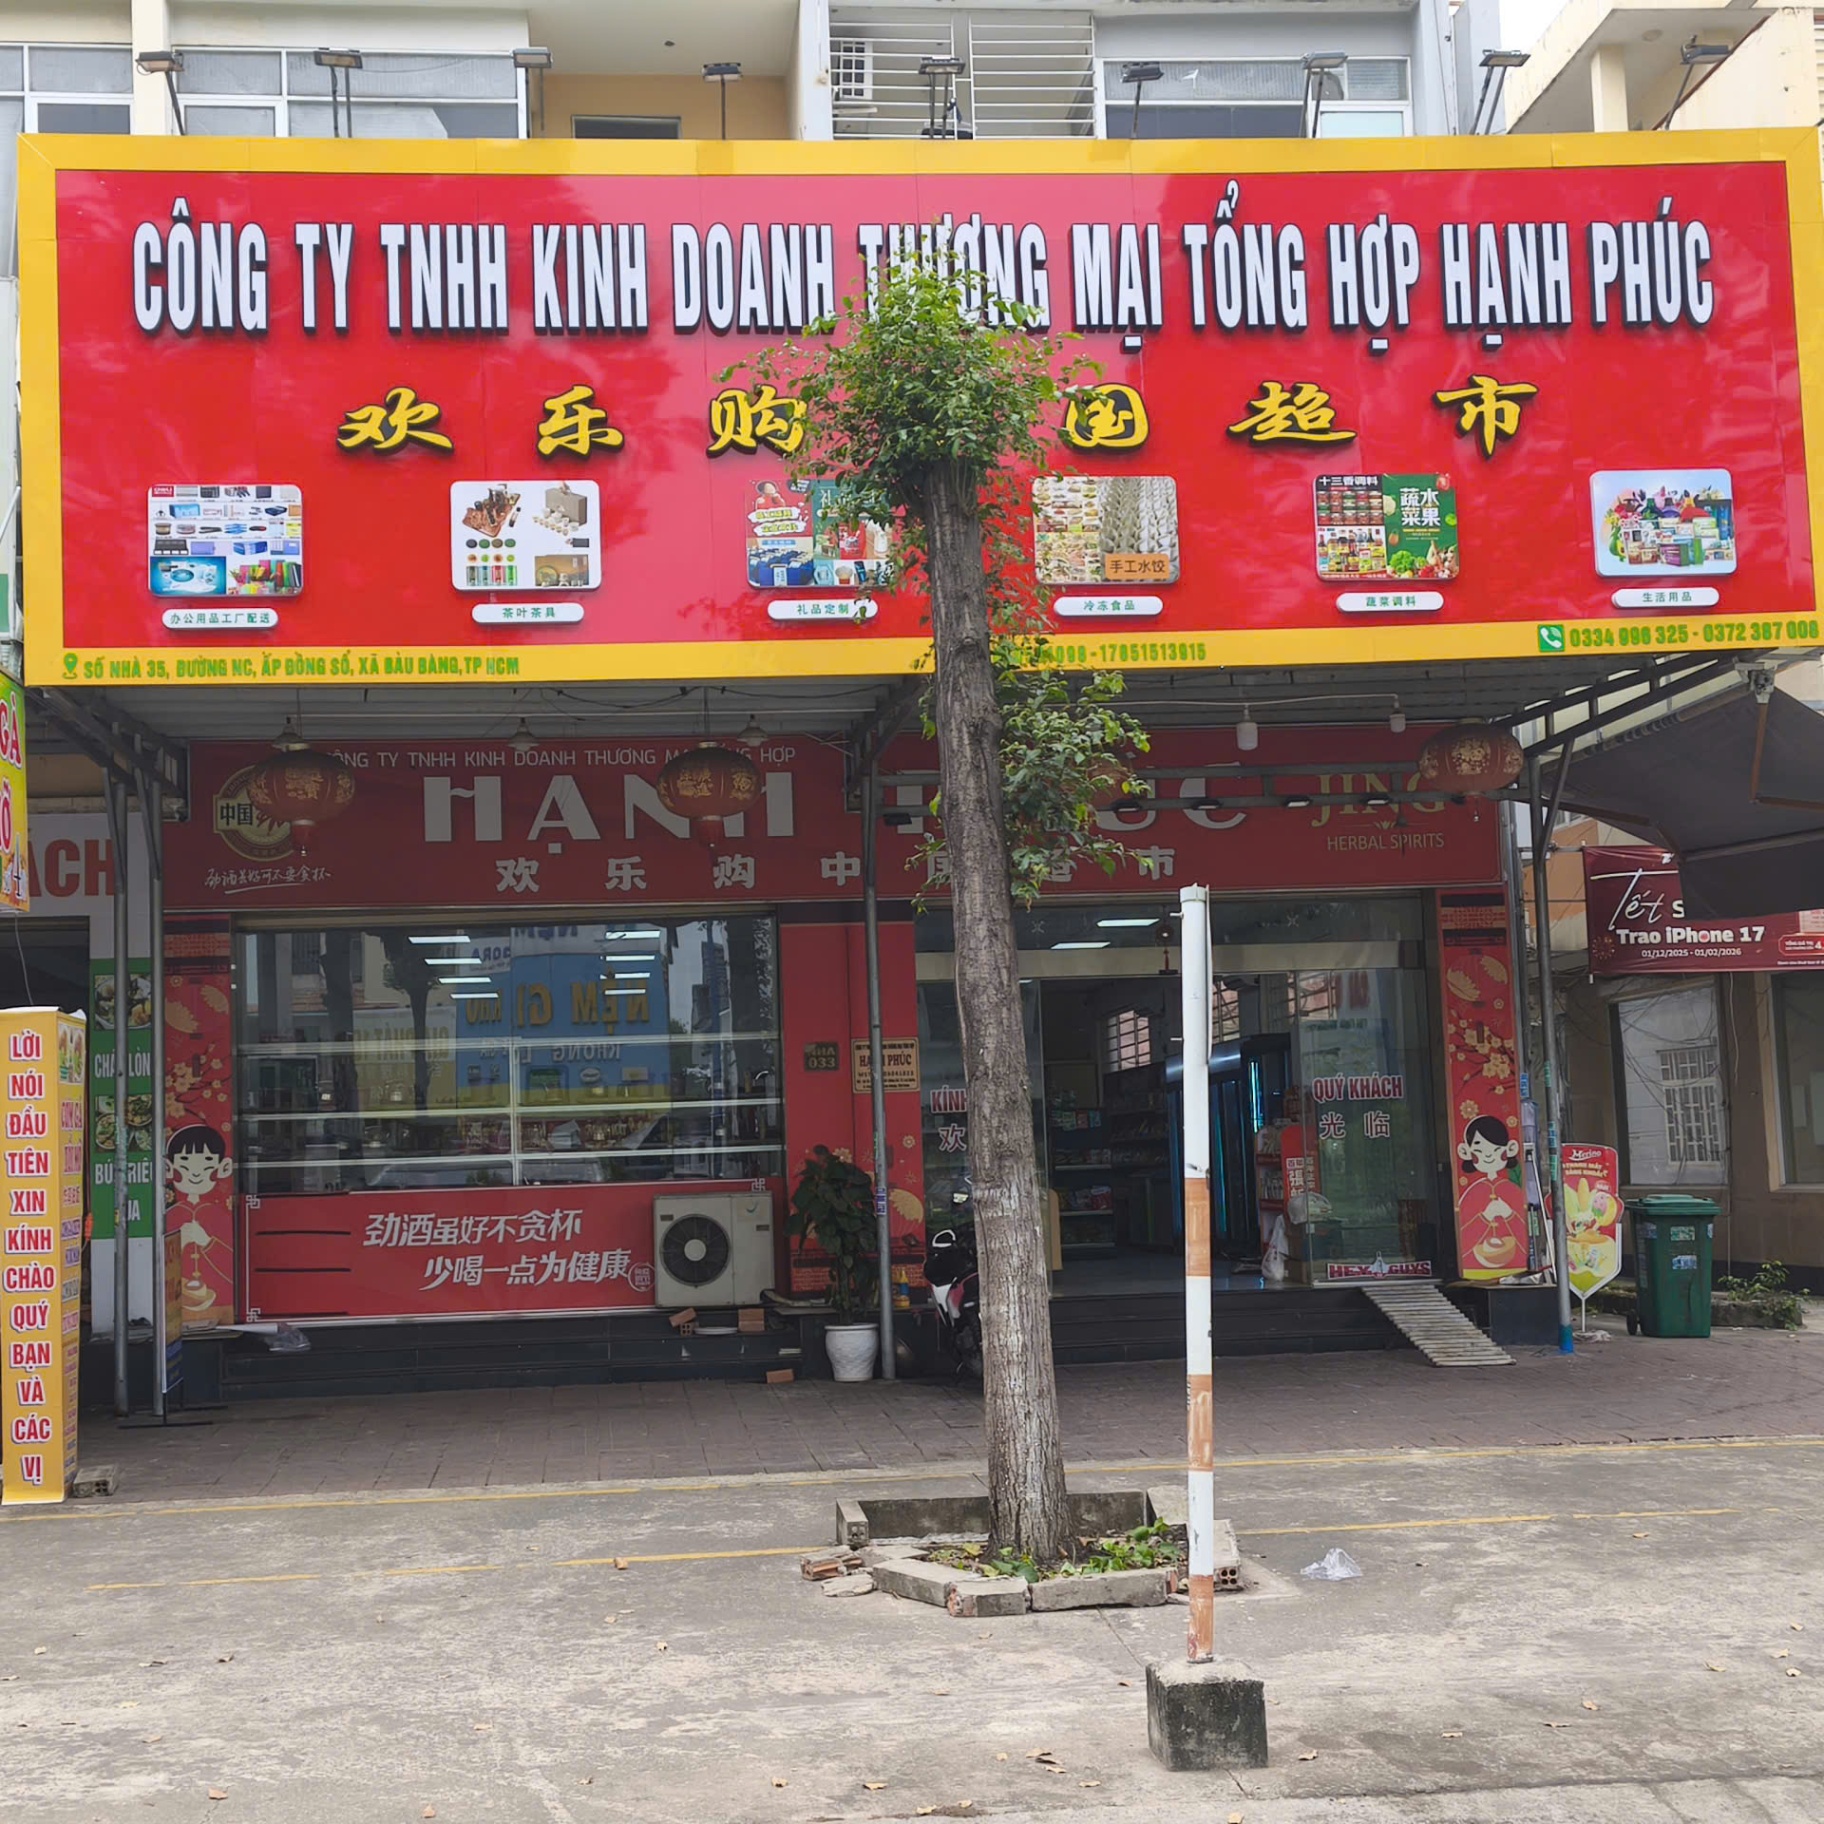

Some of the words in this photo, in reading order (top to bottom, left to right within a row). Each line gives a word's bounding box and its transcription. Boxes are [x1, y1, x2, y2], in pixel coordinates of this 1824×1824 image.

[132, 196, 268, 331] CÔNG
[294, 222, 353, 330] TY
[380, 222, 508, 330] TNHH
[532, 223, 647, 331] KINH
[672, 223, 834, 331] DOANH
[1071, 223, 1162, 352] MẠI
[1182, 180, 1308, 329] TỔNG
[1327, 214, 1419, 351] HỢP
[1440, 221, 1572, 350] HẠNH
[1588, 196, 1715, 326] PHÚC
[337, 374, 1538, 458] 欢乐购国超市
[1110, 560, 1165, 573] 手工水饺
[796, 603, 849, 615] 礼品定制
[1083, 600, 1135, 611] 冷冻食品
[1366, 595, 1416, 607] 蔬菜调料
[1642, 591, 1692, 602] 生活用品
[170, 612, 270, 624] 办公用品工厂配送
[502, 607, 555, 618] 茶叶茶具
[1569, 627, 1614, 647] 0334
[1655, 624, 1689, 644] 325
[1703, 622, 1746, 643] 0372
[110, 656, 141, 678] NHÀ
[147, 659, 169, 680] 35,
[486, 657, 519, 675] HCM
[378, 752, 398, 767] TY
[407, 751, 456, 768] TNHH
[464, 750, 505, 767] KINH
[514, 749, 576, 767] DOANH
[585, 747, 655, 766] THƯƠNG
[760, 746, 796, 767] HỢP
[220, 802, 253, 826] 中国
[1327, 835, 1387, 850] HERBAL
[1390, 833, 1445, 849] SPIRITS
[496, 845, 1175, 894] 欢乐购中市
[1616, 929, 1661, 944] Trao
[1665, 926, 1734, 944] iPhone
[1740, 926, 1765, 942] 17
[1642, 948, 1688, 958] 01/12/2025
[1695, 947, 1742, 958] 01/02/2026
[11, 1030, 42, 1061] LỜI
[887, 1051, 912, 1066] PHÚC
[11, 1071, 44, 1100] NÓI
[1312, 1073, 1345, 1103] QUÝ
[1348, 1072, 1403, 1100] KHÁCH
[8, 1110, 47, 1140] ĐẦU
[1320, 1111, 1390, 1139] 光临
[8, 1147, 50, 1176] TIÊN
[1569, 1150, 1602, 1161] Merino
[12, 1189, 46, 1215] XIN
[7, 1226, 53, 1254] KÍNH
[363, 1208, 584, 1248] 劲酒虽好不贪杯
[5, 1264, 56, 1293] CHÀO
[419, 1249, 633, 1291] 少喝一点为健康
[1328, 1264, 1373, 1280] HEY
[1388, 1261, 1431, 1277] GUYS
[13, 1303, 50, 1331] QUÝ
[12, 1340, 51, 1371] BẠN
[20, 1376, 45, 1405] VÀ
[13, 1413, 52, 1444] CÁC
[22, 1455, 43, 1485] VỊ
